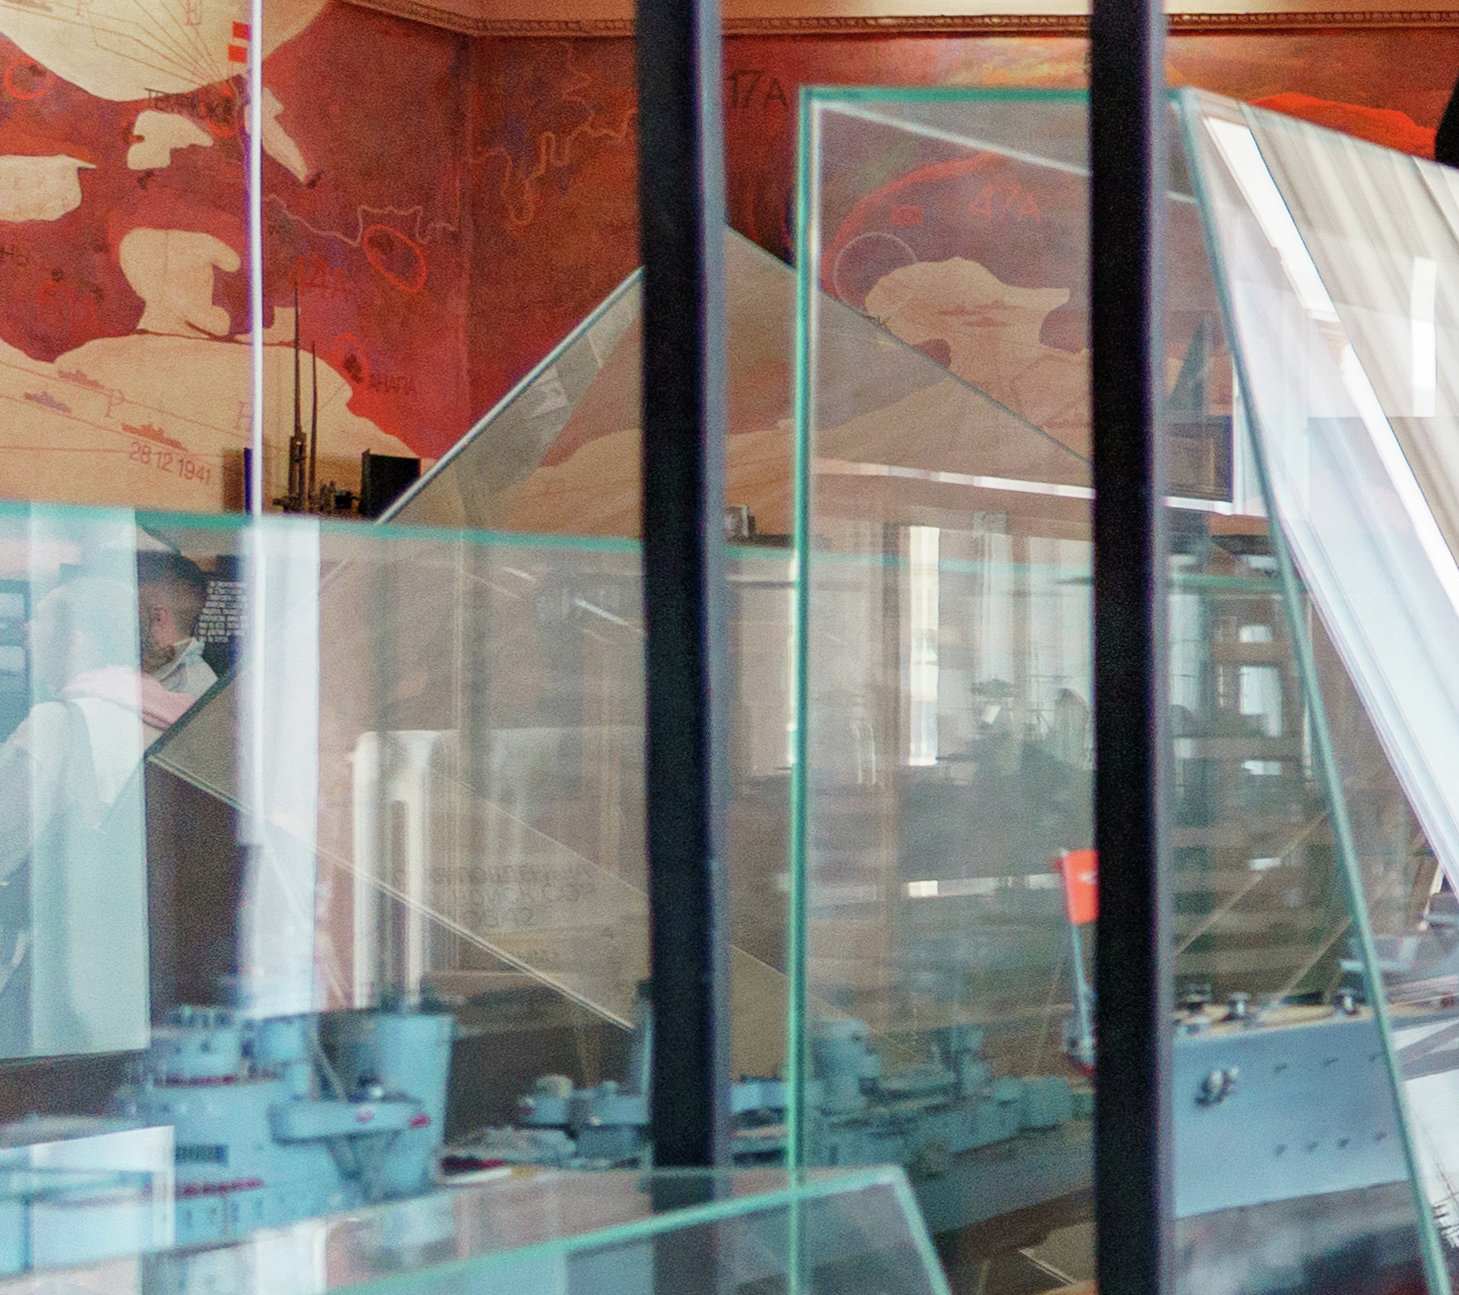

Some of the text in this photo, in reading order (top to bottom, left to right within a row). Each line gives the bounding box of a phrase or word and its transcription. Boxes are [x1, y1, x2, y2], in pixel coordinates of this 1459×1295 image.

[128, 441, 214, 485] 28 12 1941
